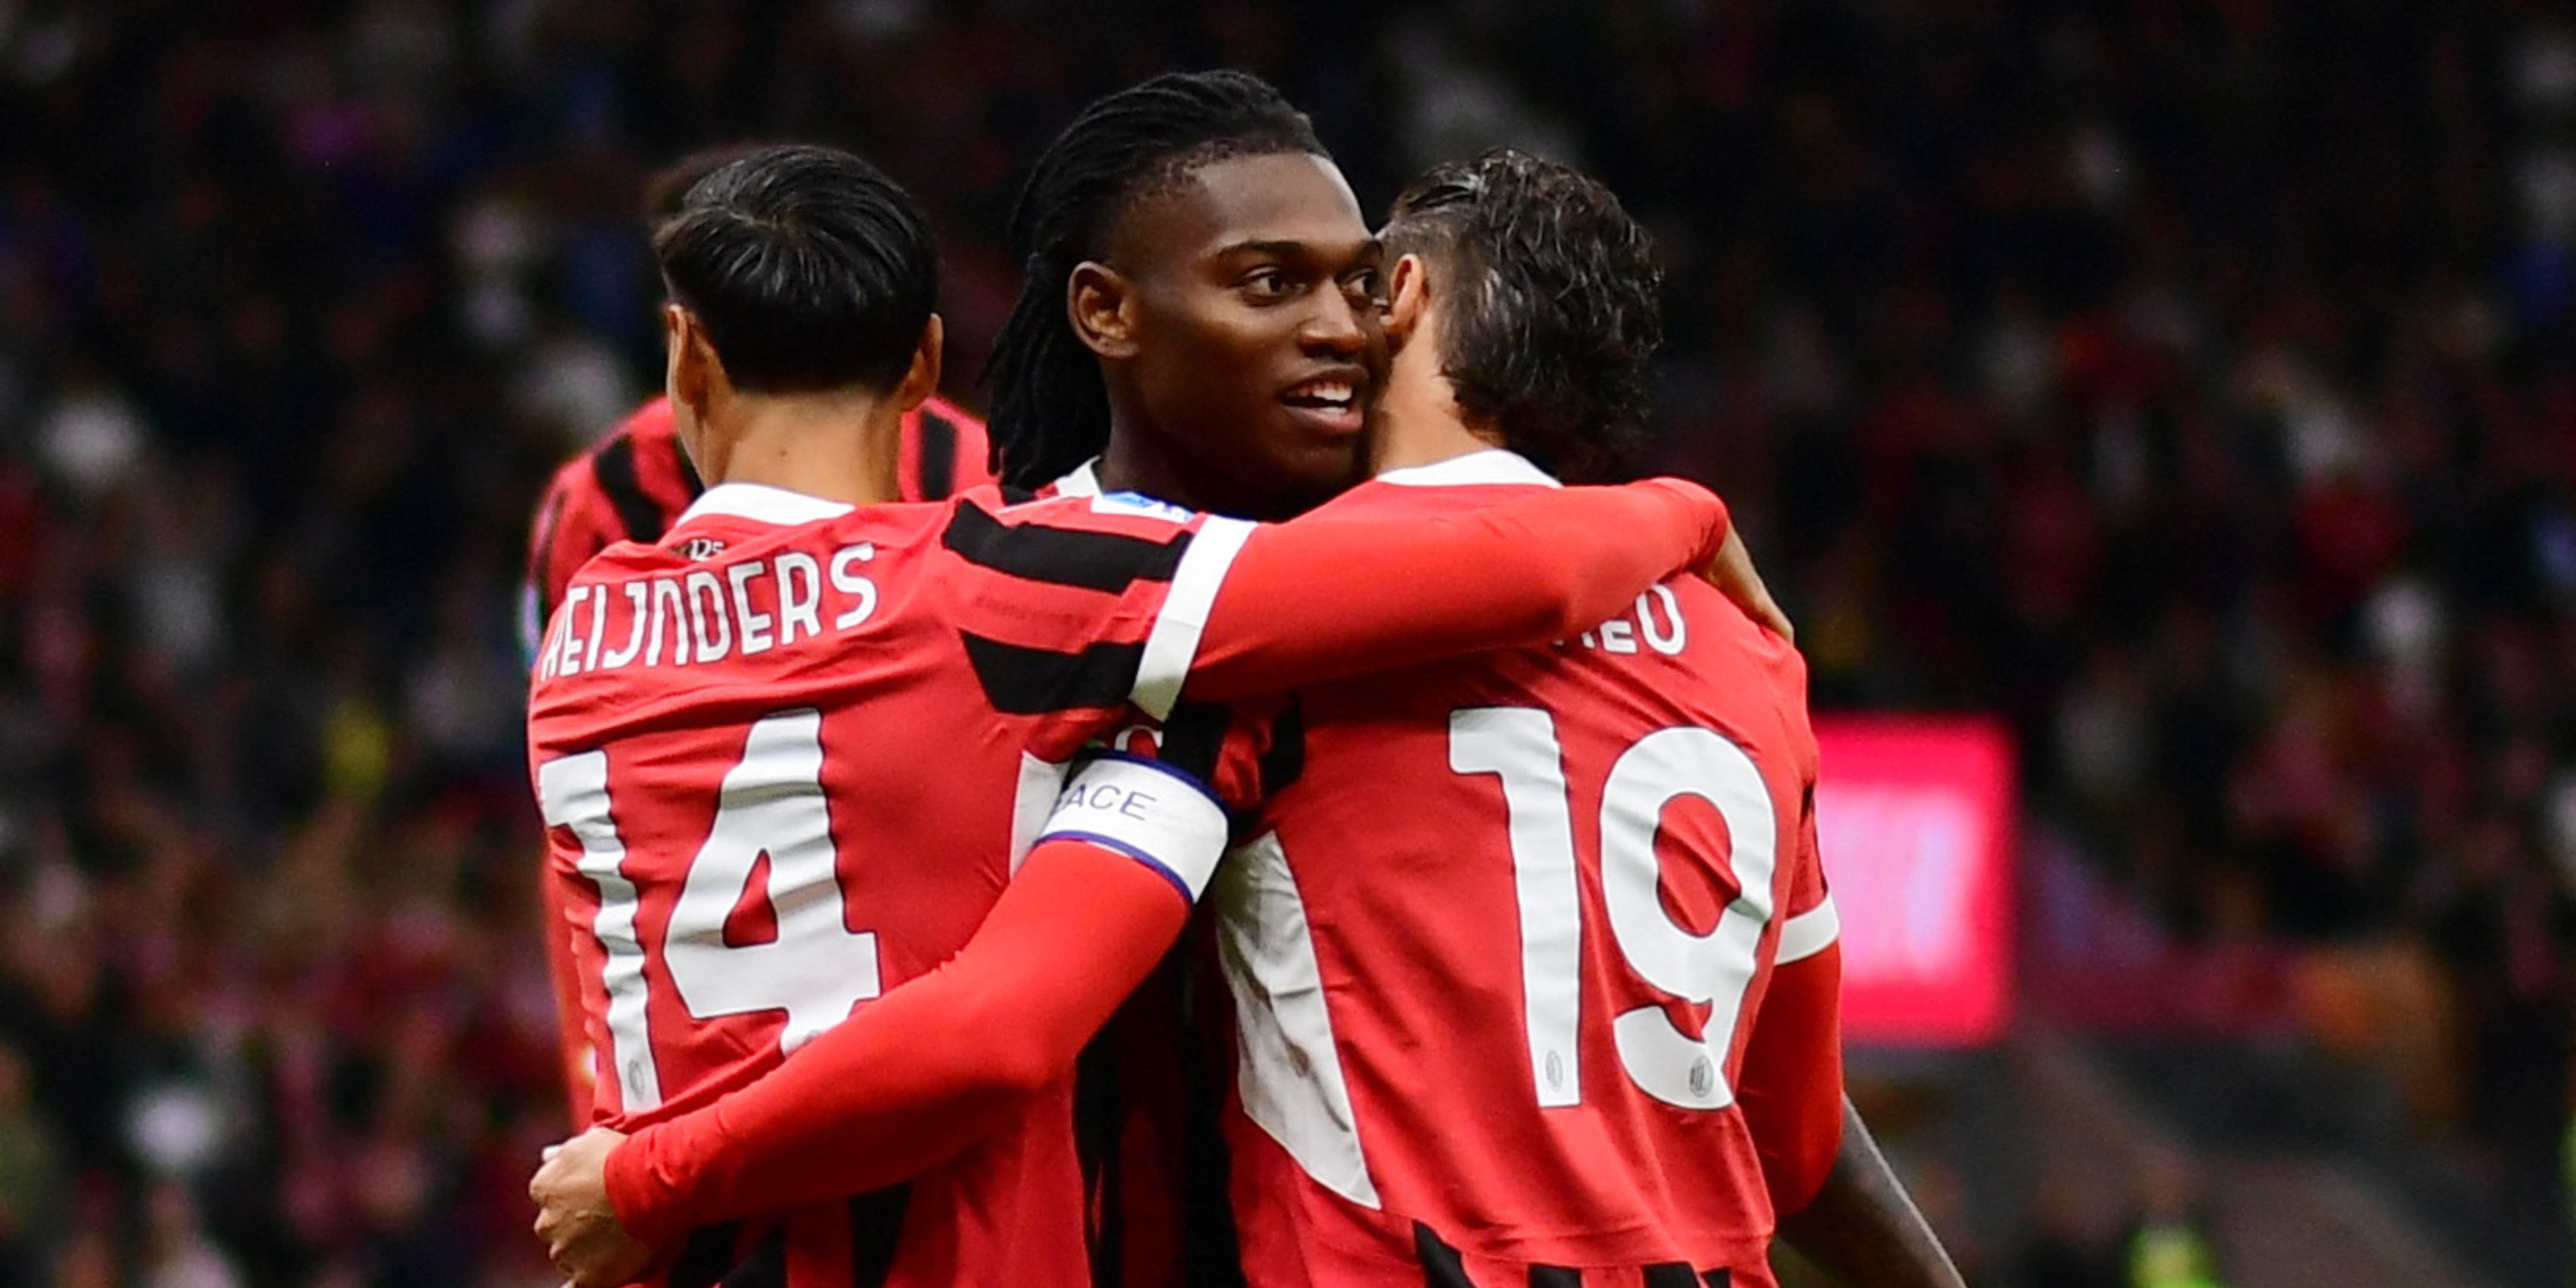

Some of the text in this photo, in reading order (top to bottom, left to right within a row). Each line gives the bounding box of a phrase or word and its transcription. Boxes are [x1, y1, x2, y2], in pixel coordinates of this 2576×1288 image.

[541, 542, 877, 683] REIJNDERS
[539, 708, 881, 1113] 14
[1050, 782, 1157, 821] ACE
[1449, 707, 1776, 1110] 19
